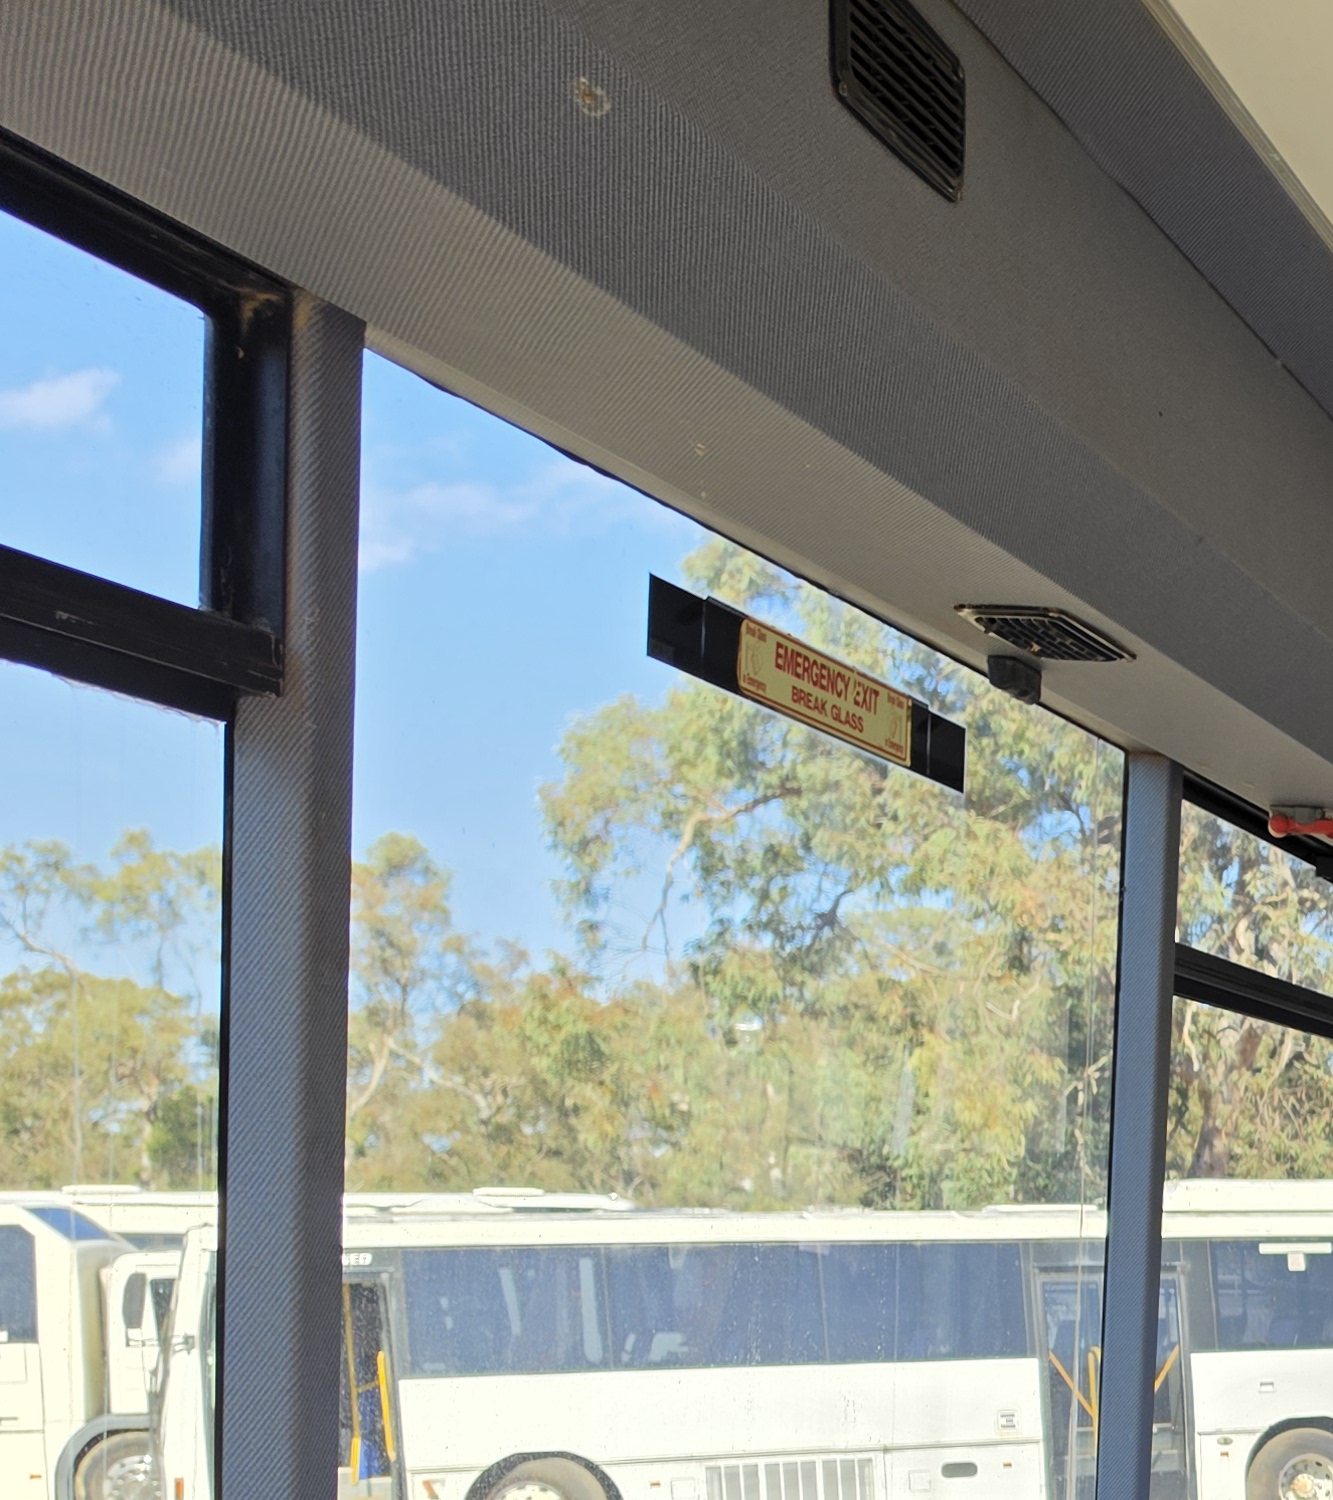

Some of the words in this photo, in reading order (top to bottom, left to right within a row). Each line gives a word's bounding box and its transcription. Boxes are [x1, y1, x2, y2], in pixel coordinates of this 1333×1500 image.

[774, 641, 851, 702] EMERGENCY
[853, 681, 880, 715] EXIT
[791, 685, 828, 717] BREAK
[830, 704, 864, 734] GLASS
